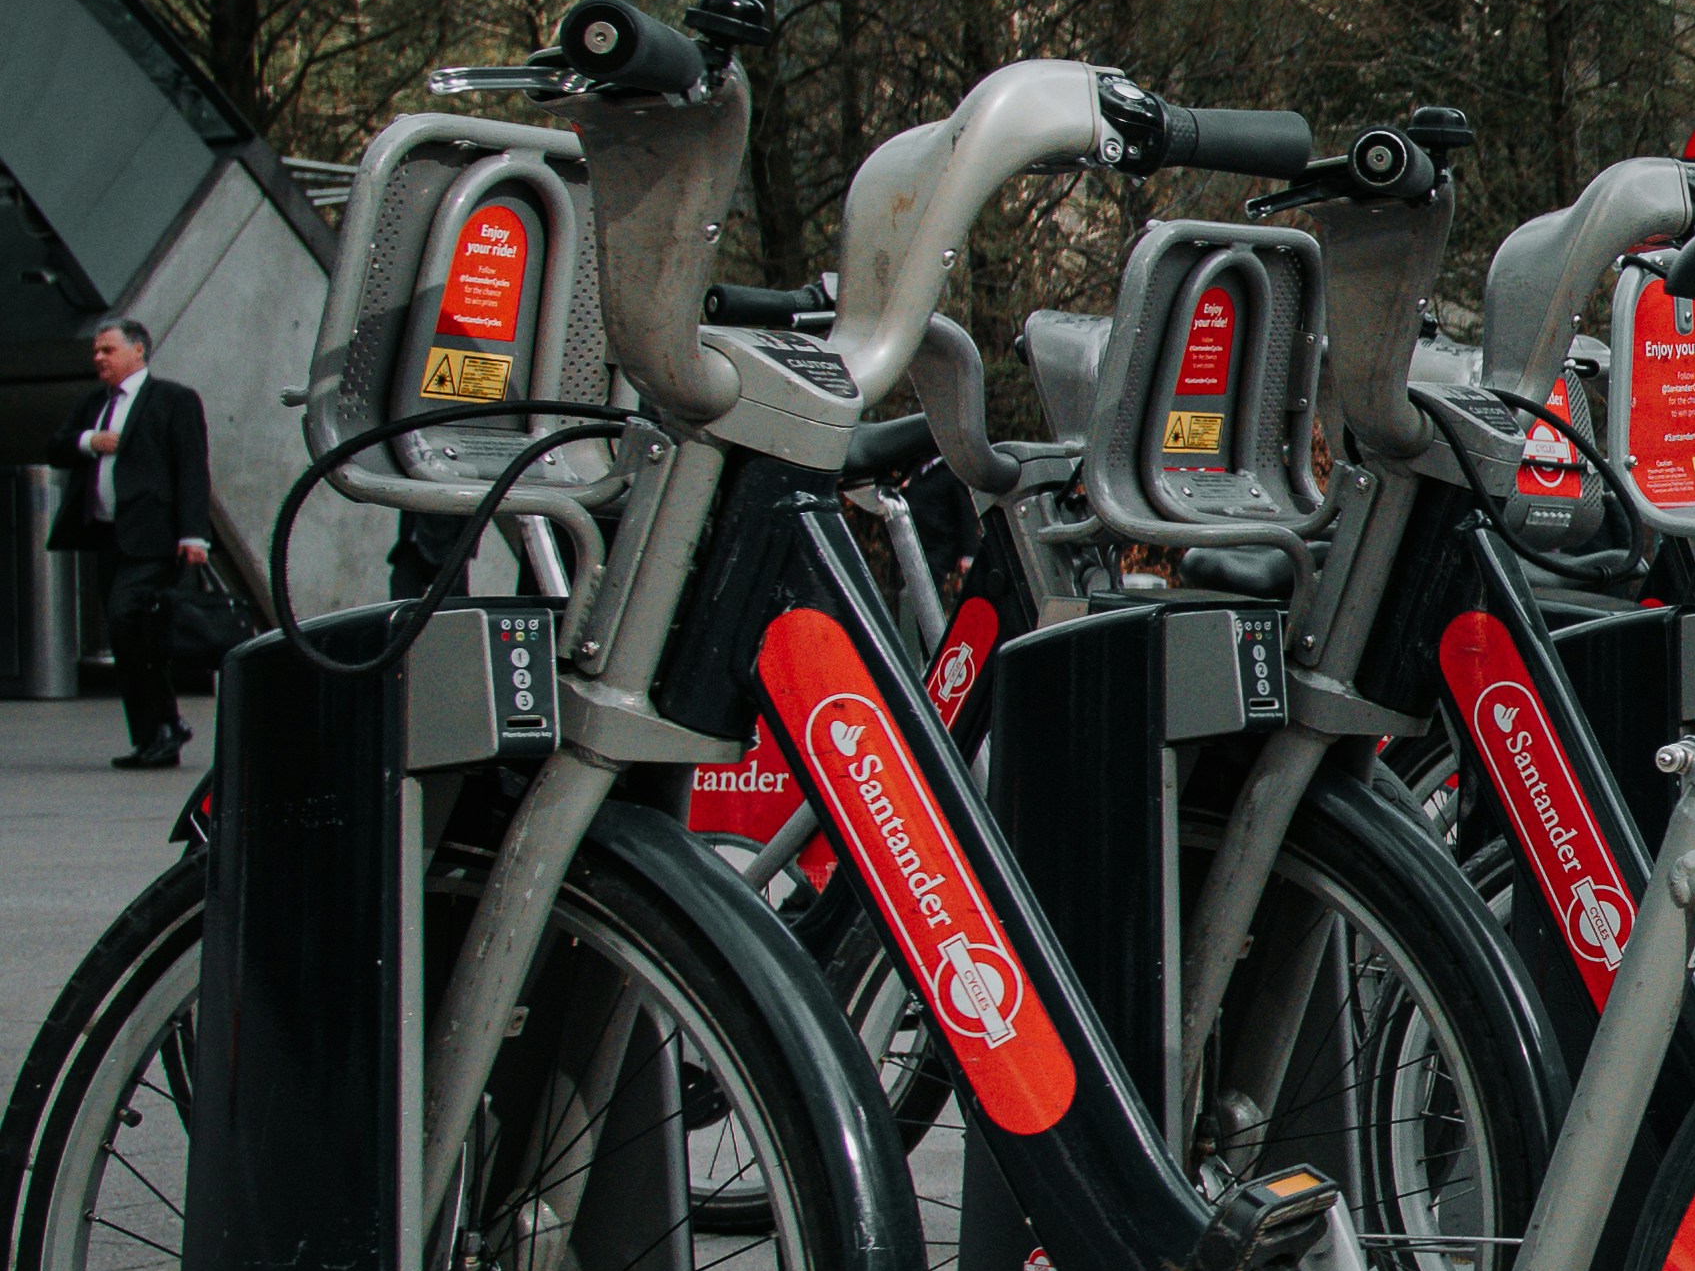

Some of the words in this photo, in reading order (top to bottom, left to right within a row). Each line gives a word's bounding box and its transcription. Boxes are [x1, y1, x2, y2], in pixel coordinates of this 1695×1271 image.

[481, 224, 511, 243] Enjoy
[465, 241, 491, 256] your
[492, 243, 517, 258] ride!
[1203, 303, 1223, 317] Enjoy
[1193, 319, 1211, 330] your
[1211, 317, 1228, 328] ride!
[1645, 340, 1674, 360] Enjoy
[1677, 371, 1695, 380] Follow
[1535, 443, 1557, 455] CYCLES
[519, 672, 527, 685] 2
[520, 694, 529, 707] 3
[502, 731, 541, 739] Membership
[693, 761, 790, 794] tander
[1506, 730, 1582, 874] Santander
[848, 754, 952, 929] Santander
[1589, 906, 1610, 941] CYCLES
[963, 969, 990, 1012] CYCLES
